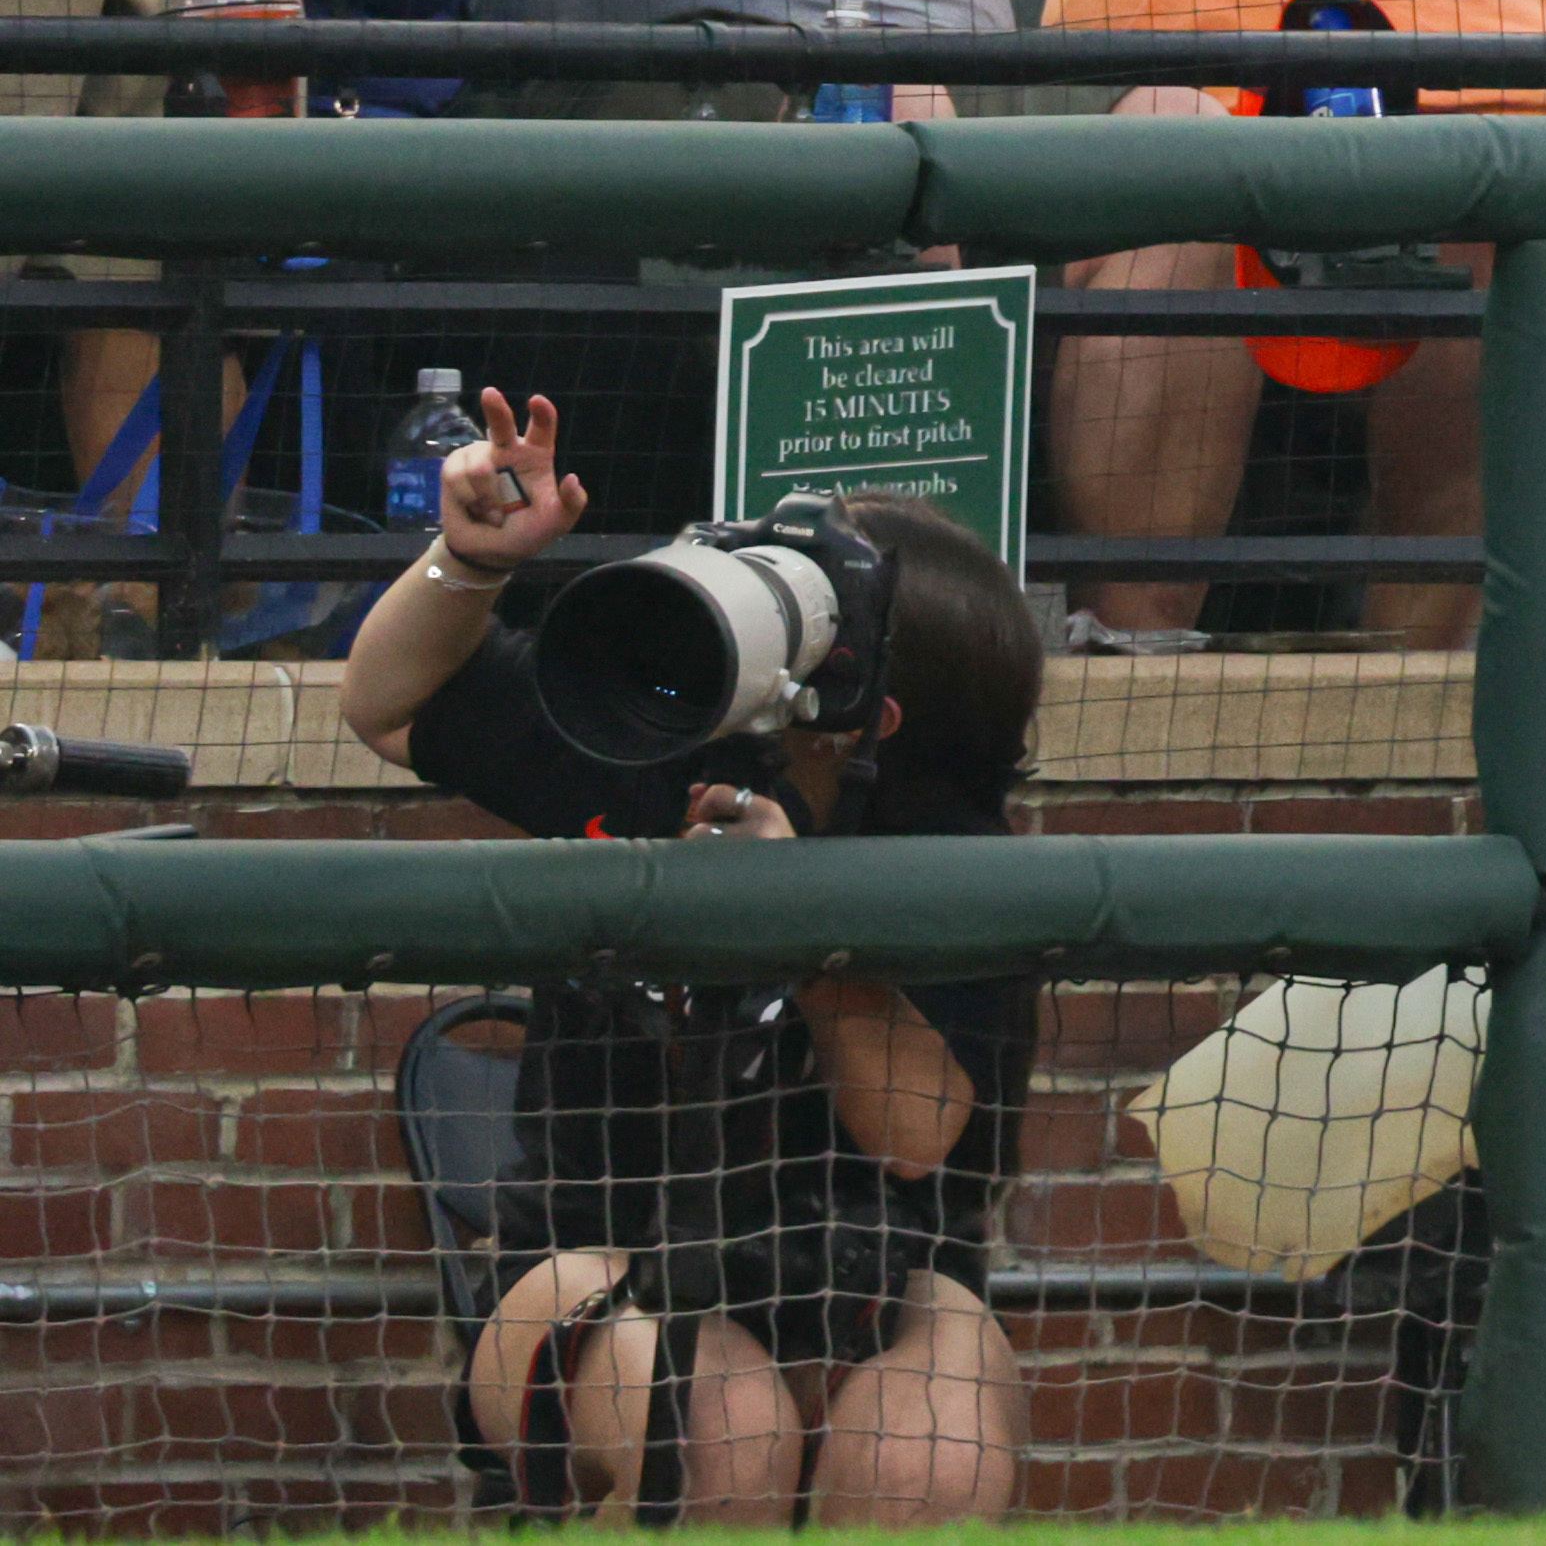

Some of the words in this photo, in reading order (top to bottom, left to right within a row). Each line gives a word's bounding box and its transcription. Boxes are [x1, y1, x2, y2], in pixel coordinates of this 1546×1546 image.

[805, 335, 853, 360] This
[858, 335, 904, 355] area
[911, 325, 955, 351] will
[822, 366, 848, 390] be
[854, 359, 934, 387] cleared
[804, 400, 827, 422] 15
[832, 388, 951, 420] MINUTES
[778, 435, 834, 463] prior
[839, 431, 862, 451] to
[866, 424, 911, 449] first
[916, 418, 973, 452] pitch
